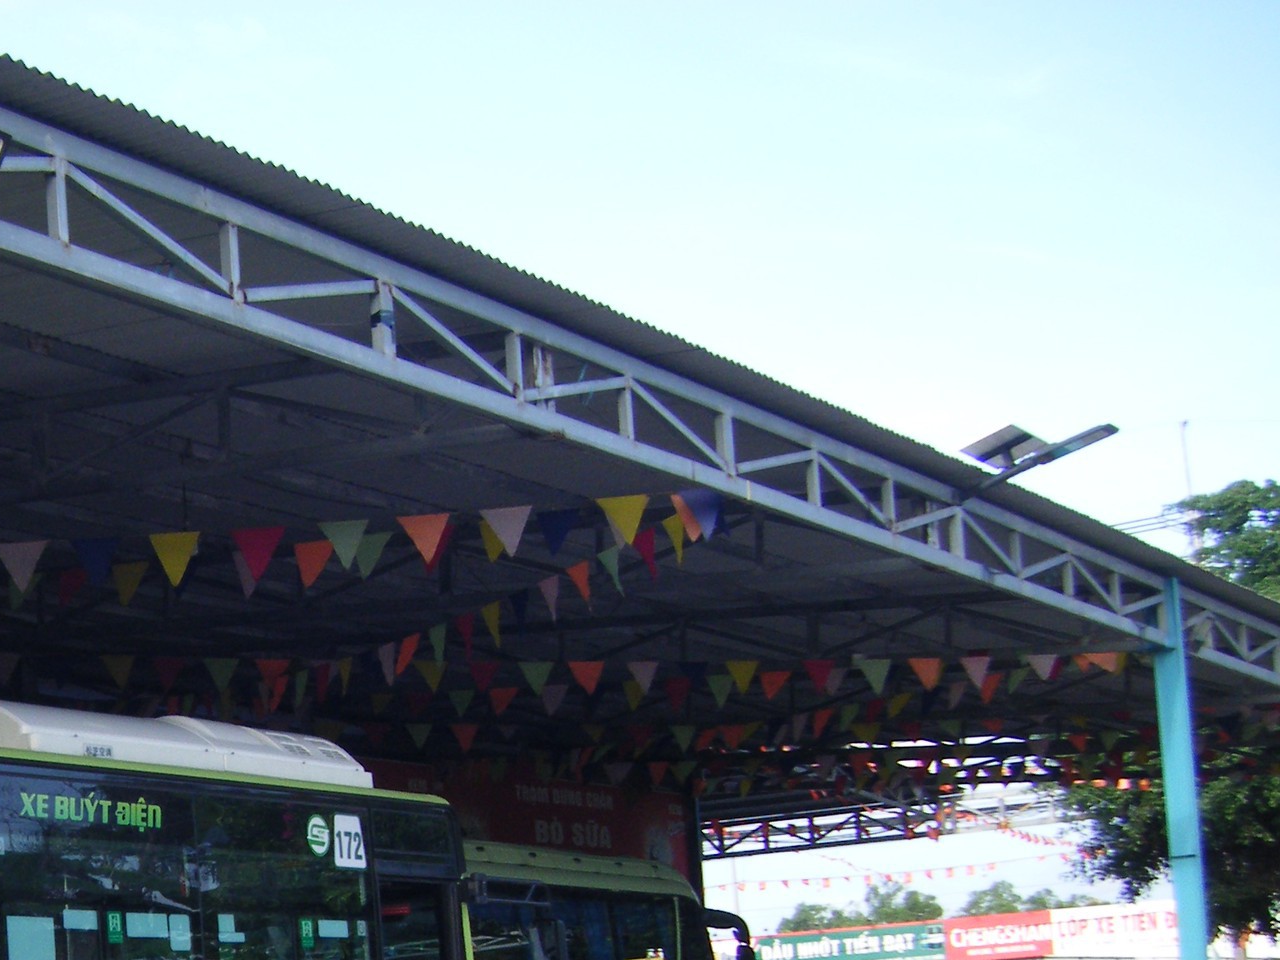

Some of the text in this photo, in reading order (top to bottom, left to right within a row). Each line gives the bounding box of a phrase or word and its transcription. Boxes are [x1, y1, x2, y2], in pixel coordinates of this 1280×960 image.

[19, 792, 48, 819] XE
[54, 791, 112, 824] BUÝT
[335, 829, 364, 861] 172
[949, 922, 1051, 948] CHENGSHAN
